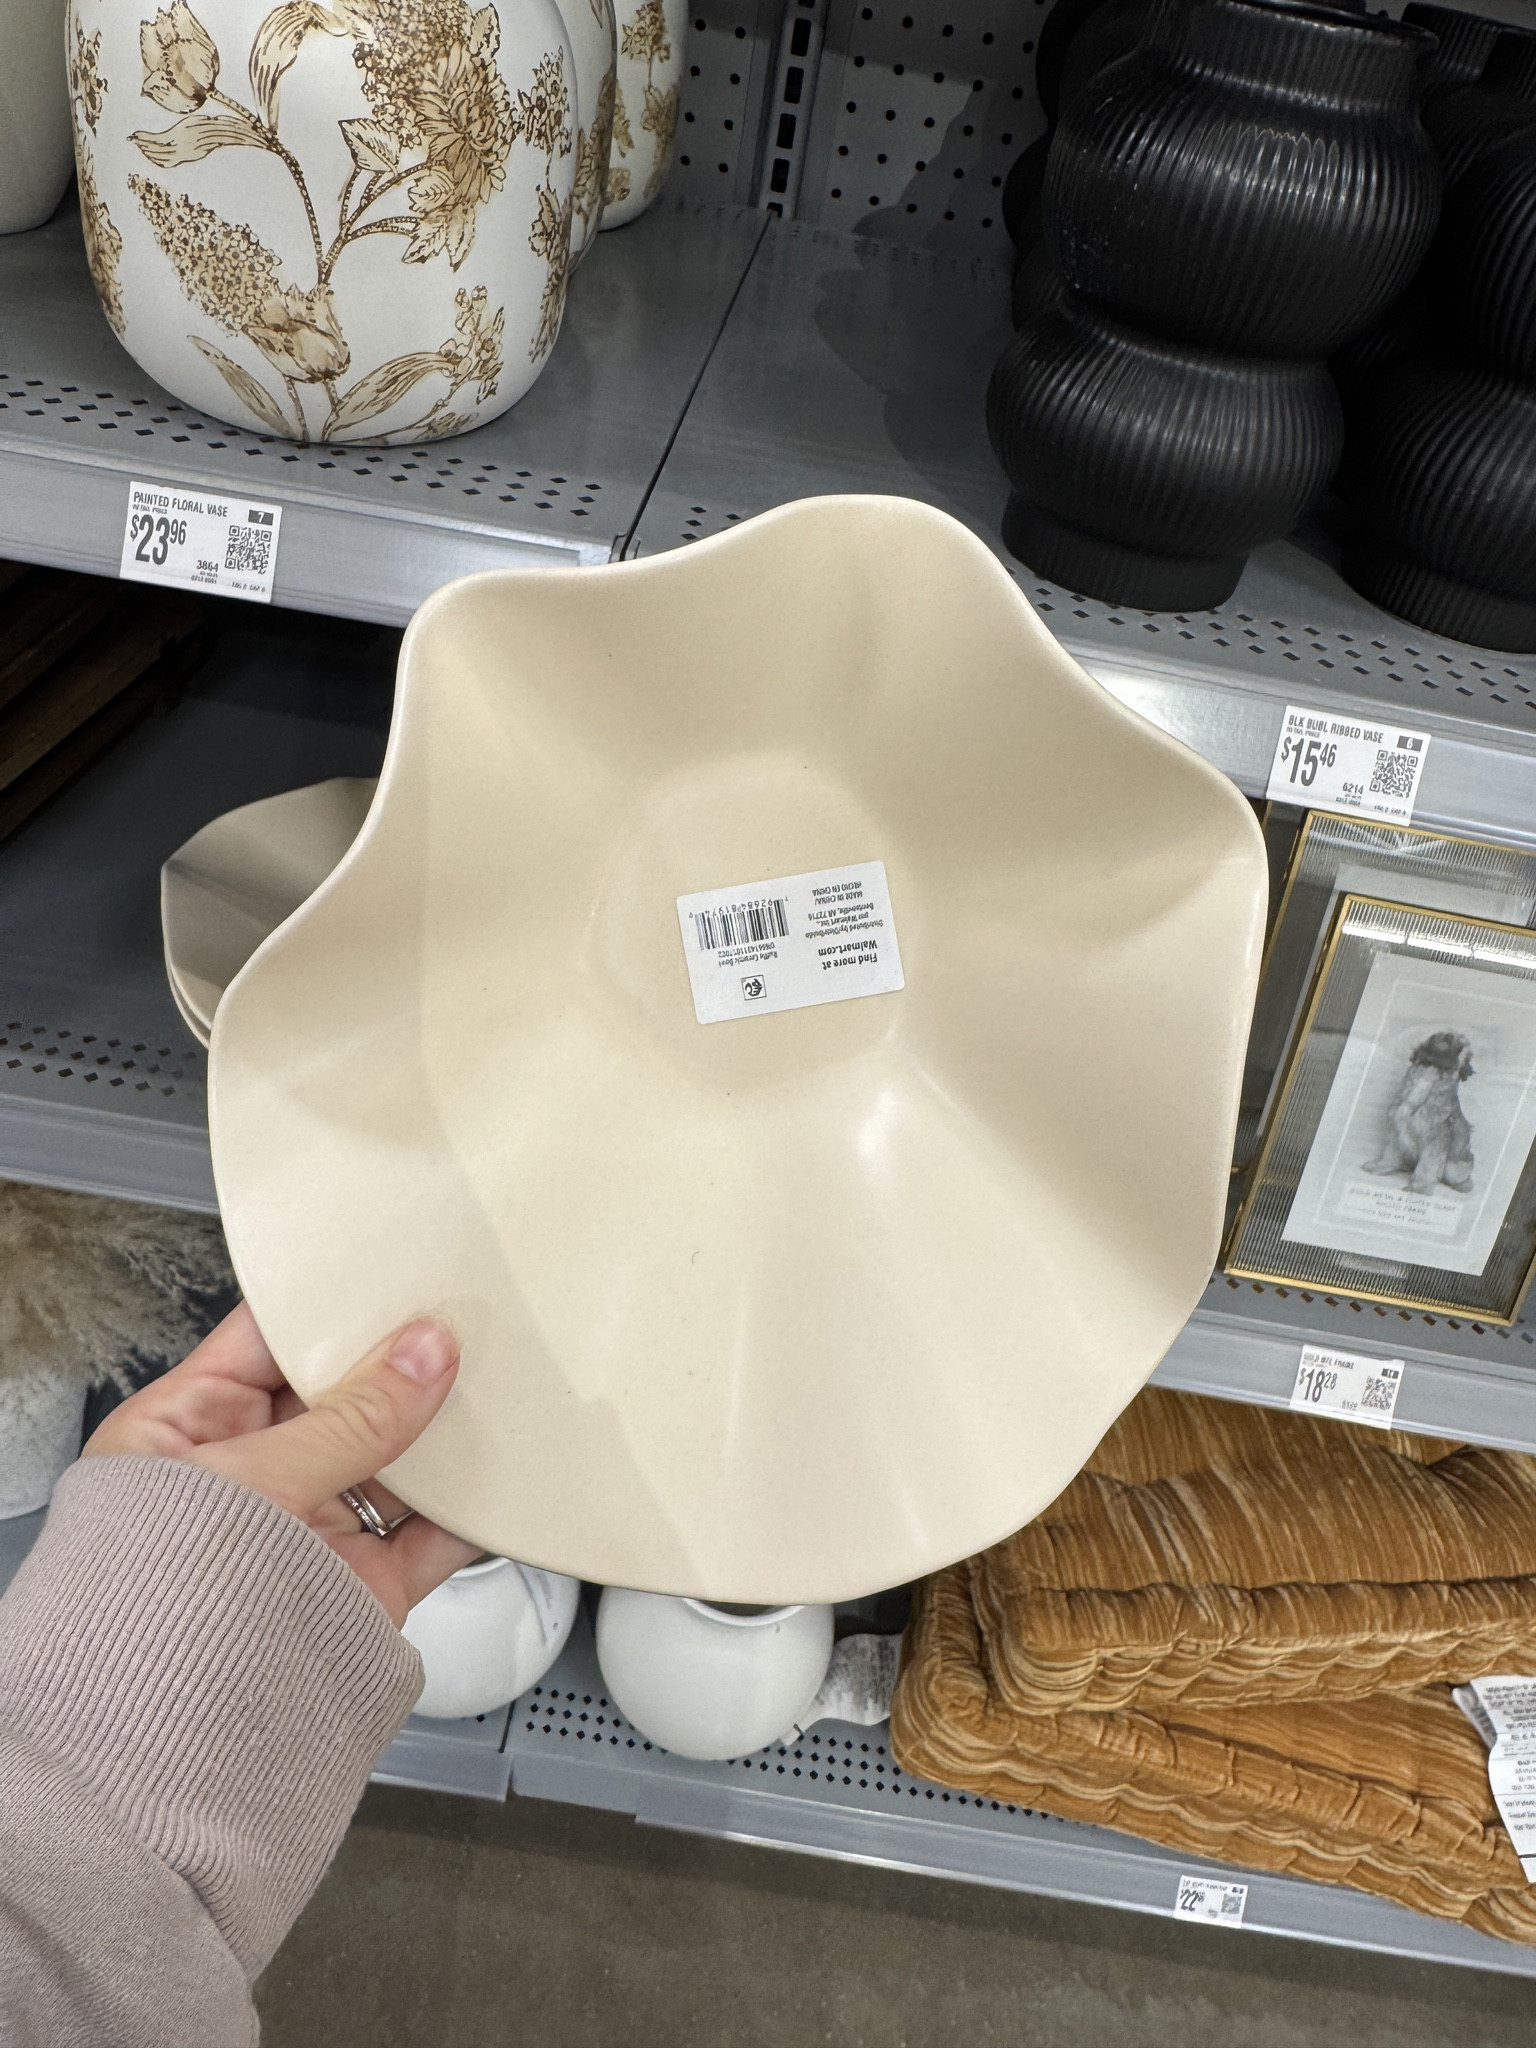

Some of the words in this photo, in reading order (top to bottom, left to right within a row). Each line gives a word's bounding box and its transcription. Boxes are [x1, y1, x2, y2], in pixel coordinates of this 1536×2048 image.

[134, 492, 169, 508] PAINTED
[172, 498, 204, 513] FLORAL
[207, 503, 228, 517] VASE
[257, 513, 264, 522] 7
[196, 560, 219, 572] 3864
[1288, 715, 1304, 726] BLK
[1331, 723, 1360, 738] RIBBED
[1363, 729, 1384, 743] VASE
[1343, 782, 1364, 794] 6214
[811, 886, 830, 896] CHINA
[831, 884, 840, 892] EN
[845, 890, 862, 899] MADE
[818, 939, 877, 958] Walmart.com
[734, 953, 758, 964] Ceramic
[832, 956, 856, 967] more
[857, 952, 877, 964] Find
[821, 960, 832, 970] at
